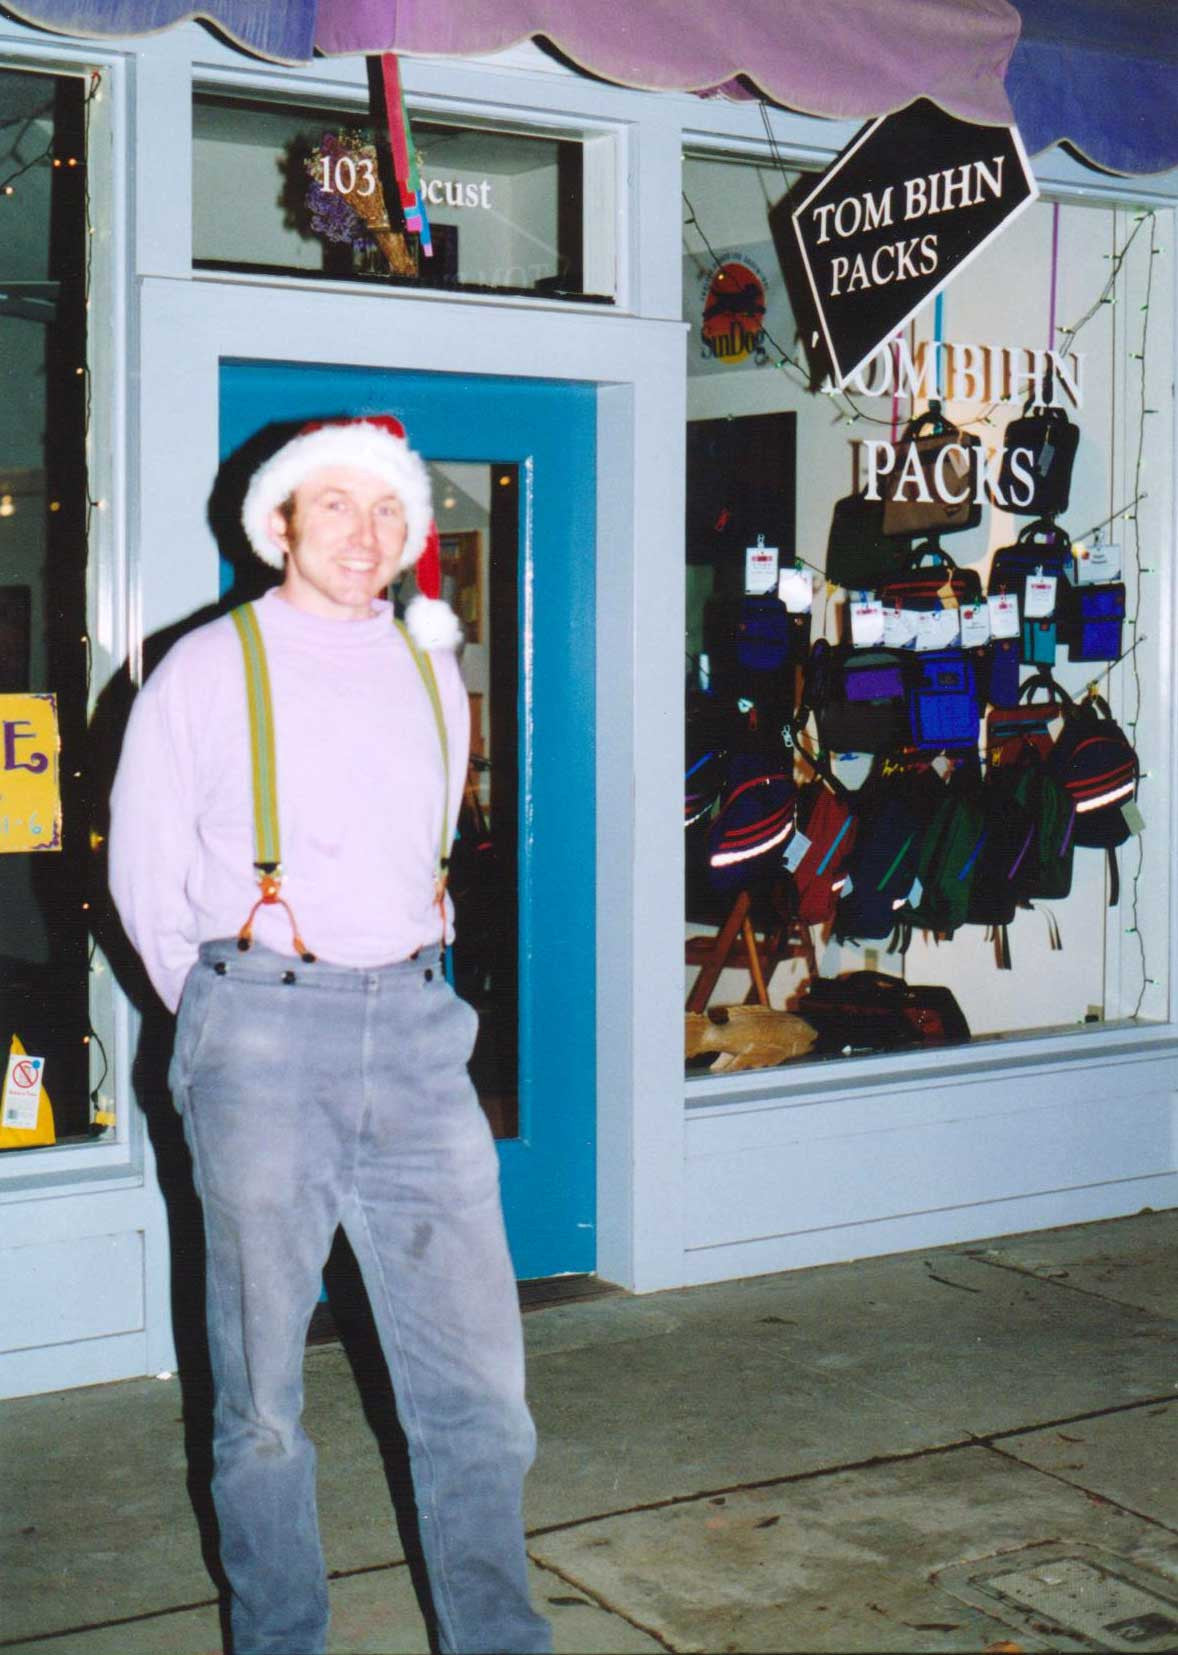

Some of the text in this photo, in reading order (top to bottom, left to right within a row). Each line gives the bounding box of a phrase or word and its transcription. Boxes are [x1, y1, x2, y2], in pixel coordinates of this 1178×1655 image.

[319, 155, 377, 197] 103
[812, 156, 1005, 245] TOM BIHN
[830, 234, 939, 297] PACKS
[952, 342, 1089, 409] BIHN
[863, 439, 1035, 507] PACKS
